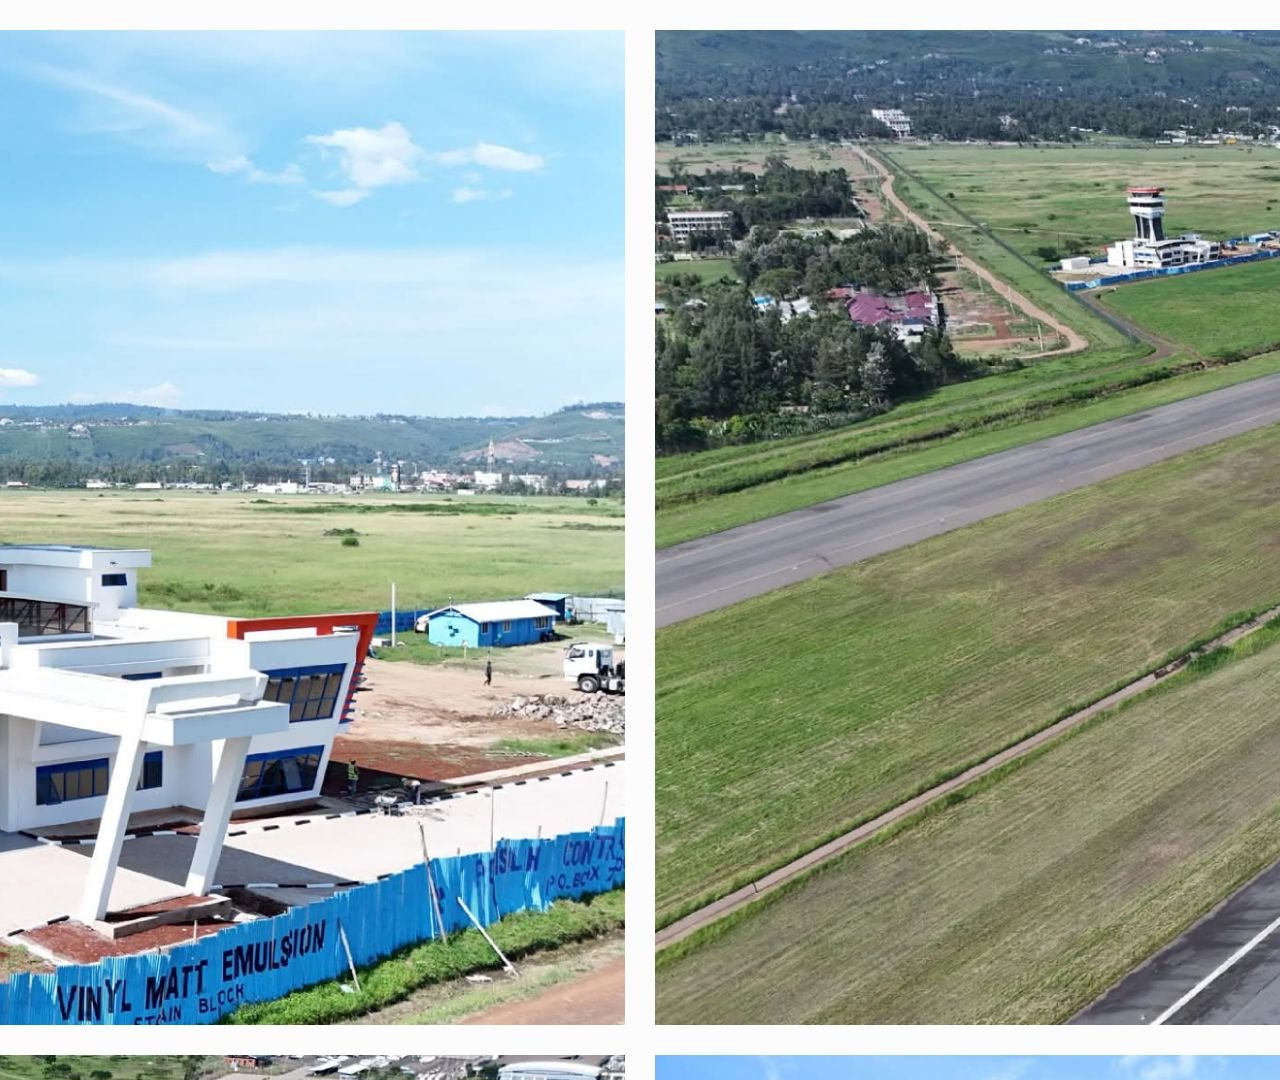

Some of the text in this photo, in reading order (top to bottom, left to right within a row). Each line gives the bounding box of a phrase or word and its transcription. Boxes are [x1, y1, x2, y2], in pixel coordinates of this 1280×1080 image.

[56, 920, 326, 1021] VINYL MATT EMULSION
[199, 984, 245, 1014] BLOCK
